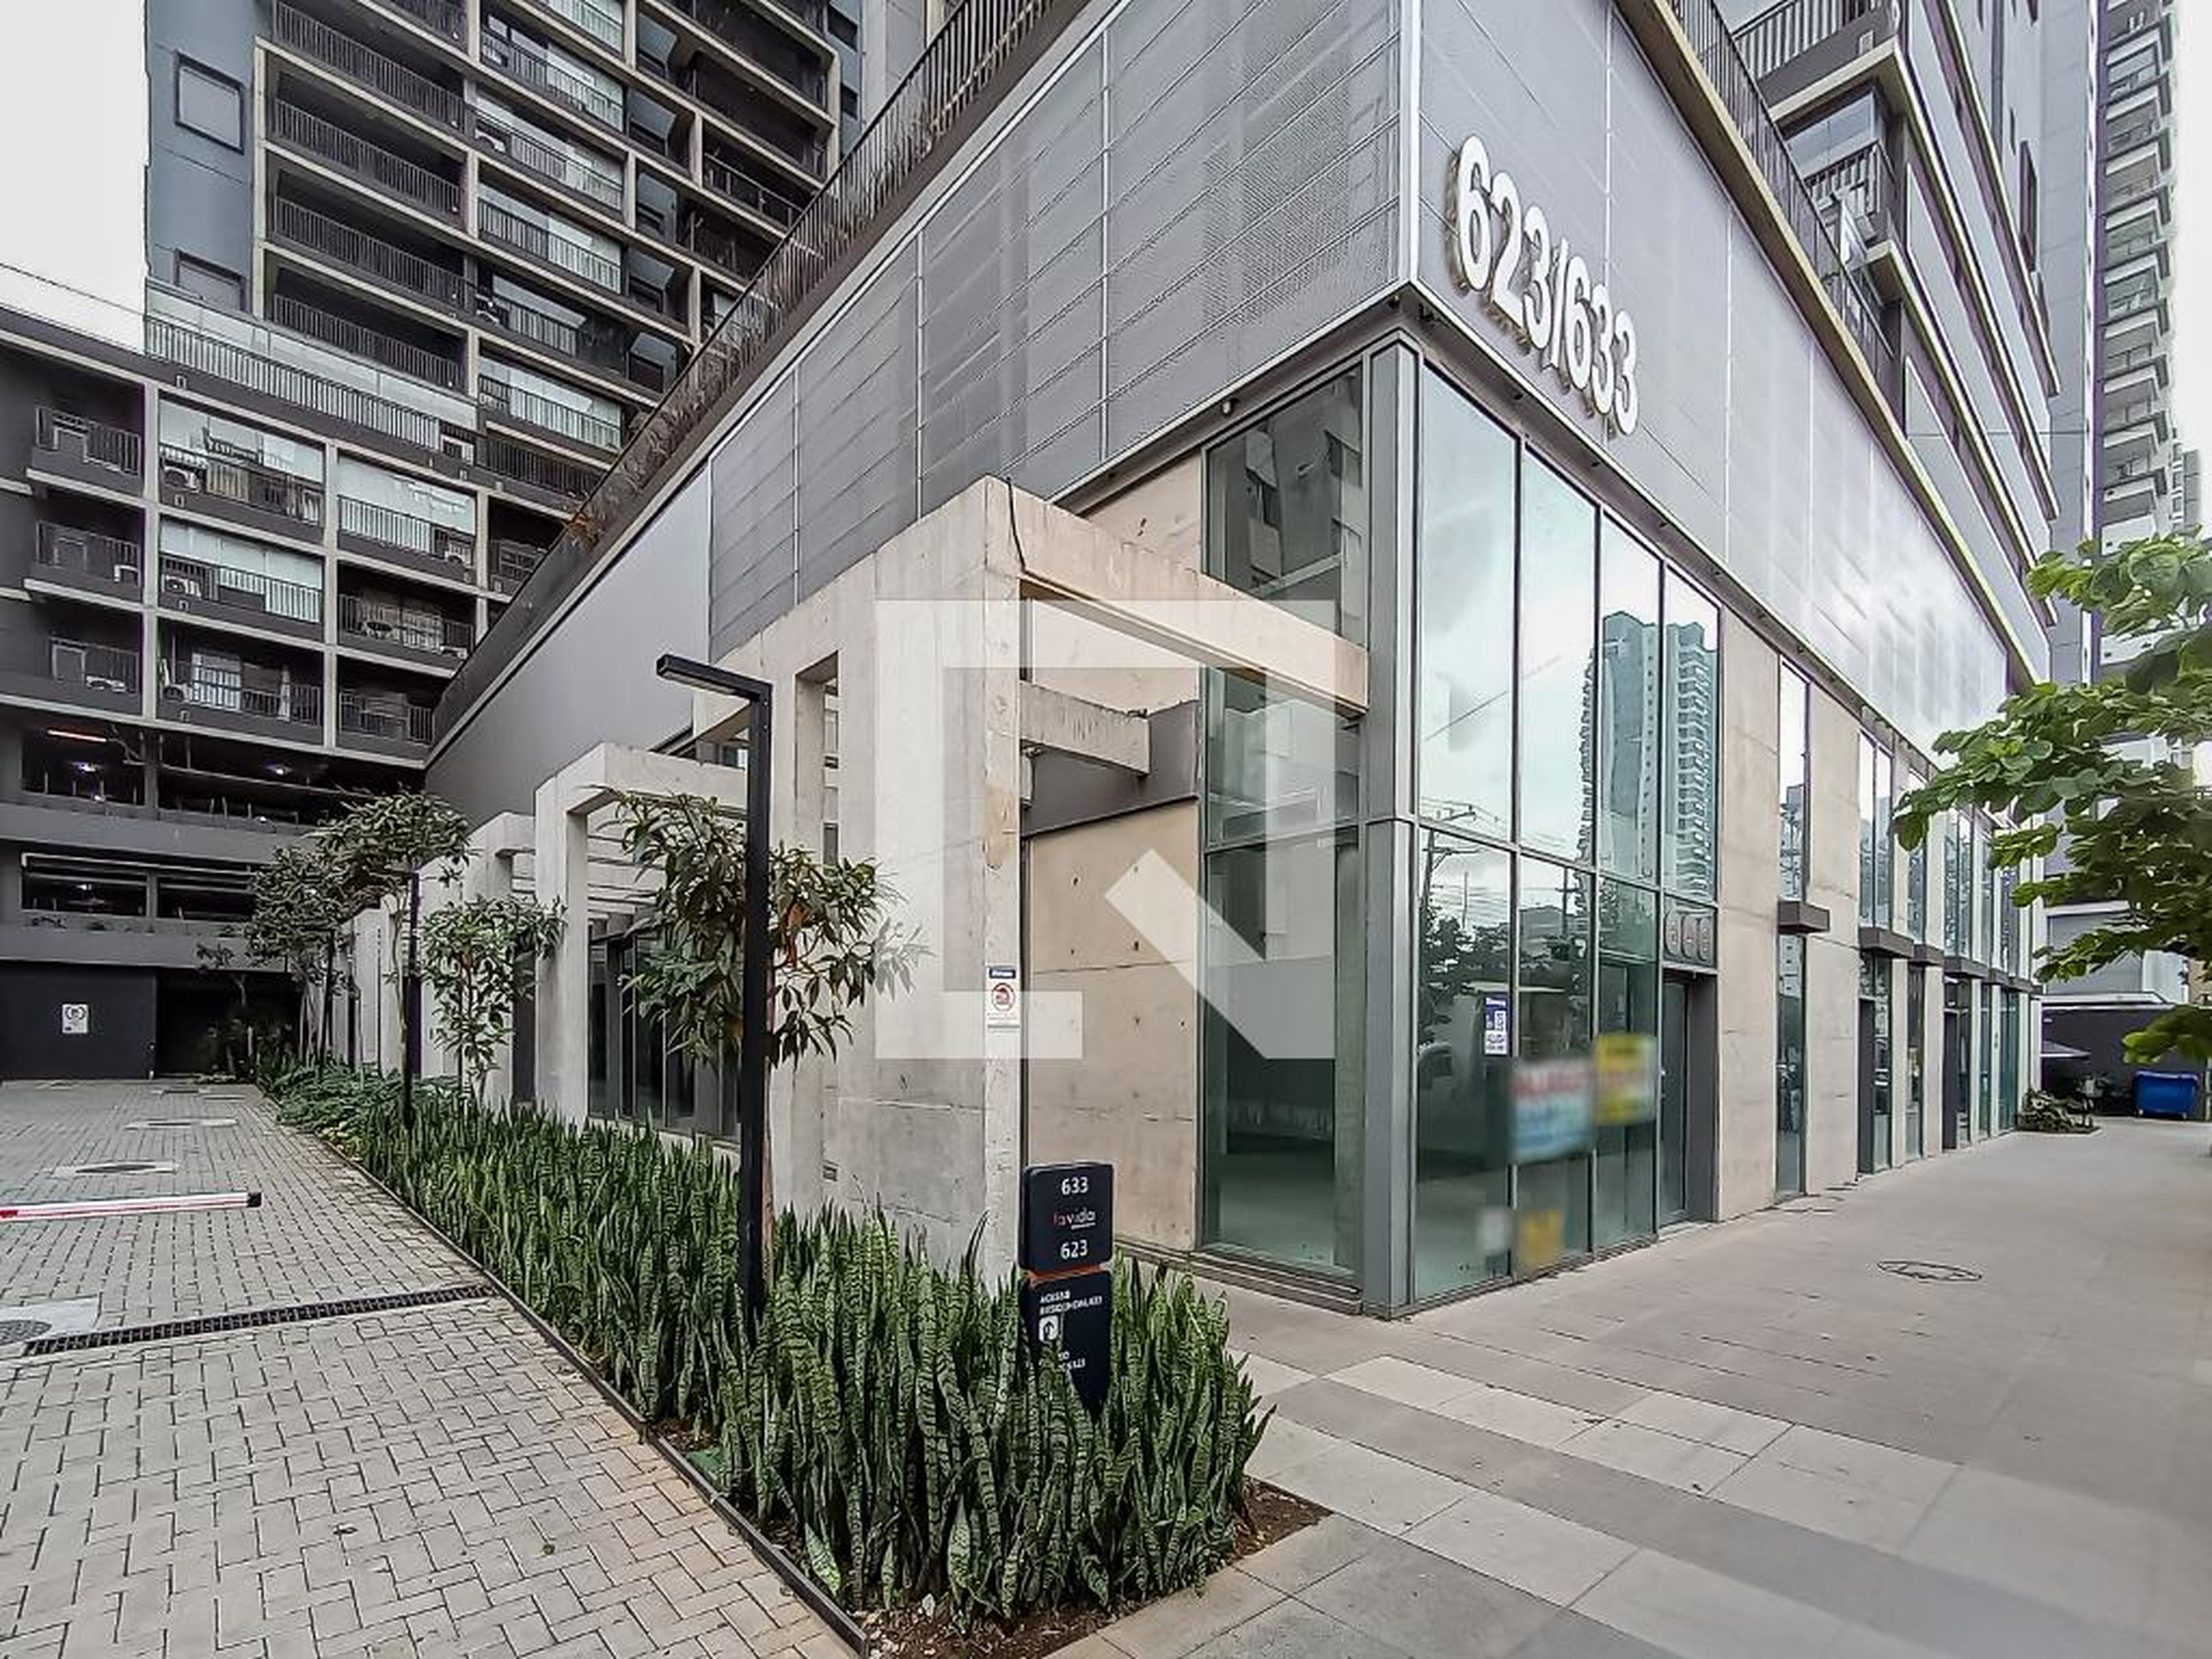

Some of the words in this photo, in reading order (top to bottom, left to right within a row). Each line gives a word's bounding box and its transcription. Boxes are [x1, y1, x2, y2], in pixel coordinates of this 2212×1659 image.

[1457, 134, 1638, 436] 623/633
[1061, 1176, 1088, 1195] 633
[1060, 1239, 1088, 1260] 623
